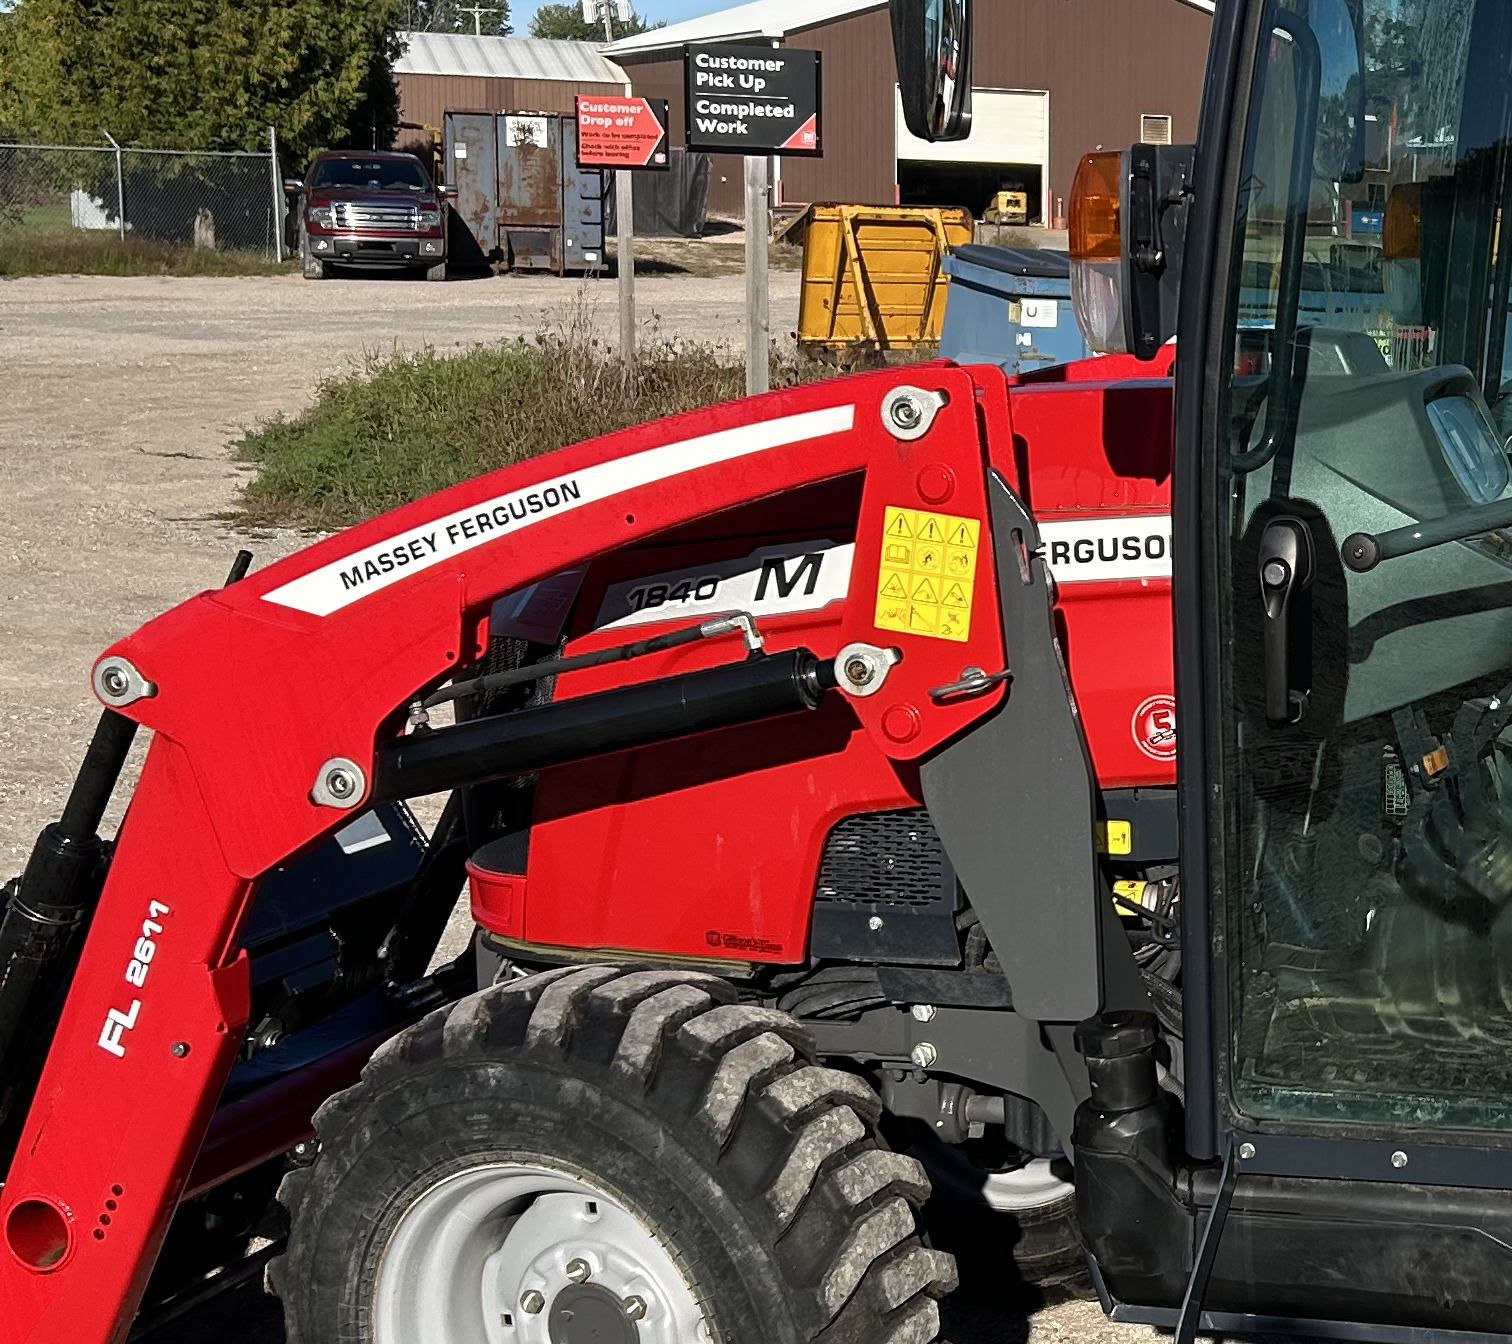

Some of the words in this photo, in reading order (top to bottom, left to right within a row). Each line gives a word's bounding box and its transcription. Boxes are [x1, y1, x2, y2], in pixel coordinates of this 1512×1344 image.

[695, 53, 785, 71] Customer
[696, 71, 735, 87] Pick
[739, 73, 766, 92] Up
[579, 101, 644, 114] Customer
[696, 99, 795, 119] Completed
[580, 114, 612, 128] Drop
[615, 116, 635, 127] off
[695, 118, 748, 134] Work
[339, 532, 438, 590] MASSEY
[446, 480, 581, 545] FERGUSON
[628, 578, 720, 611] 1840
[753, 553, 825, 602] M
[97, 999, 142, 1058] FL
[125, 899, 170, 988] 2611
